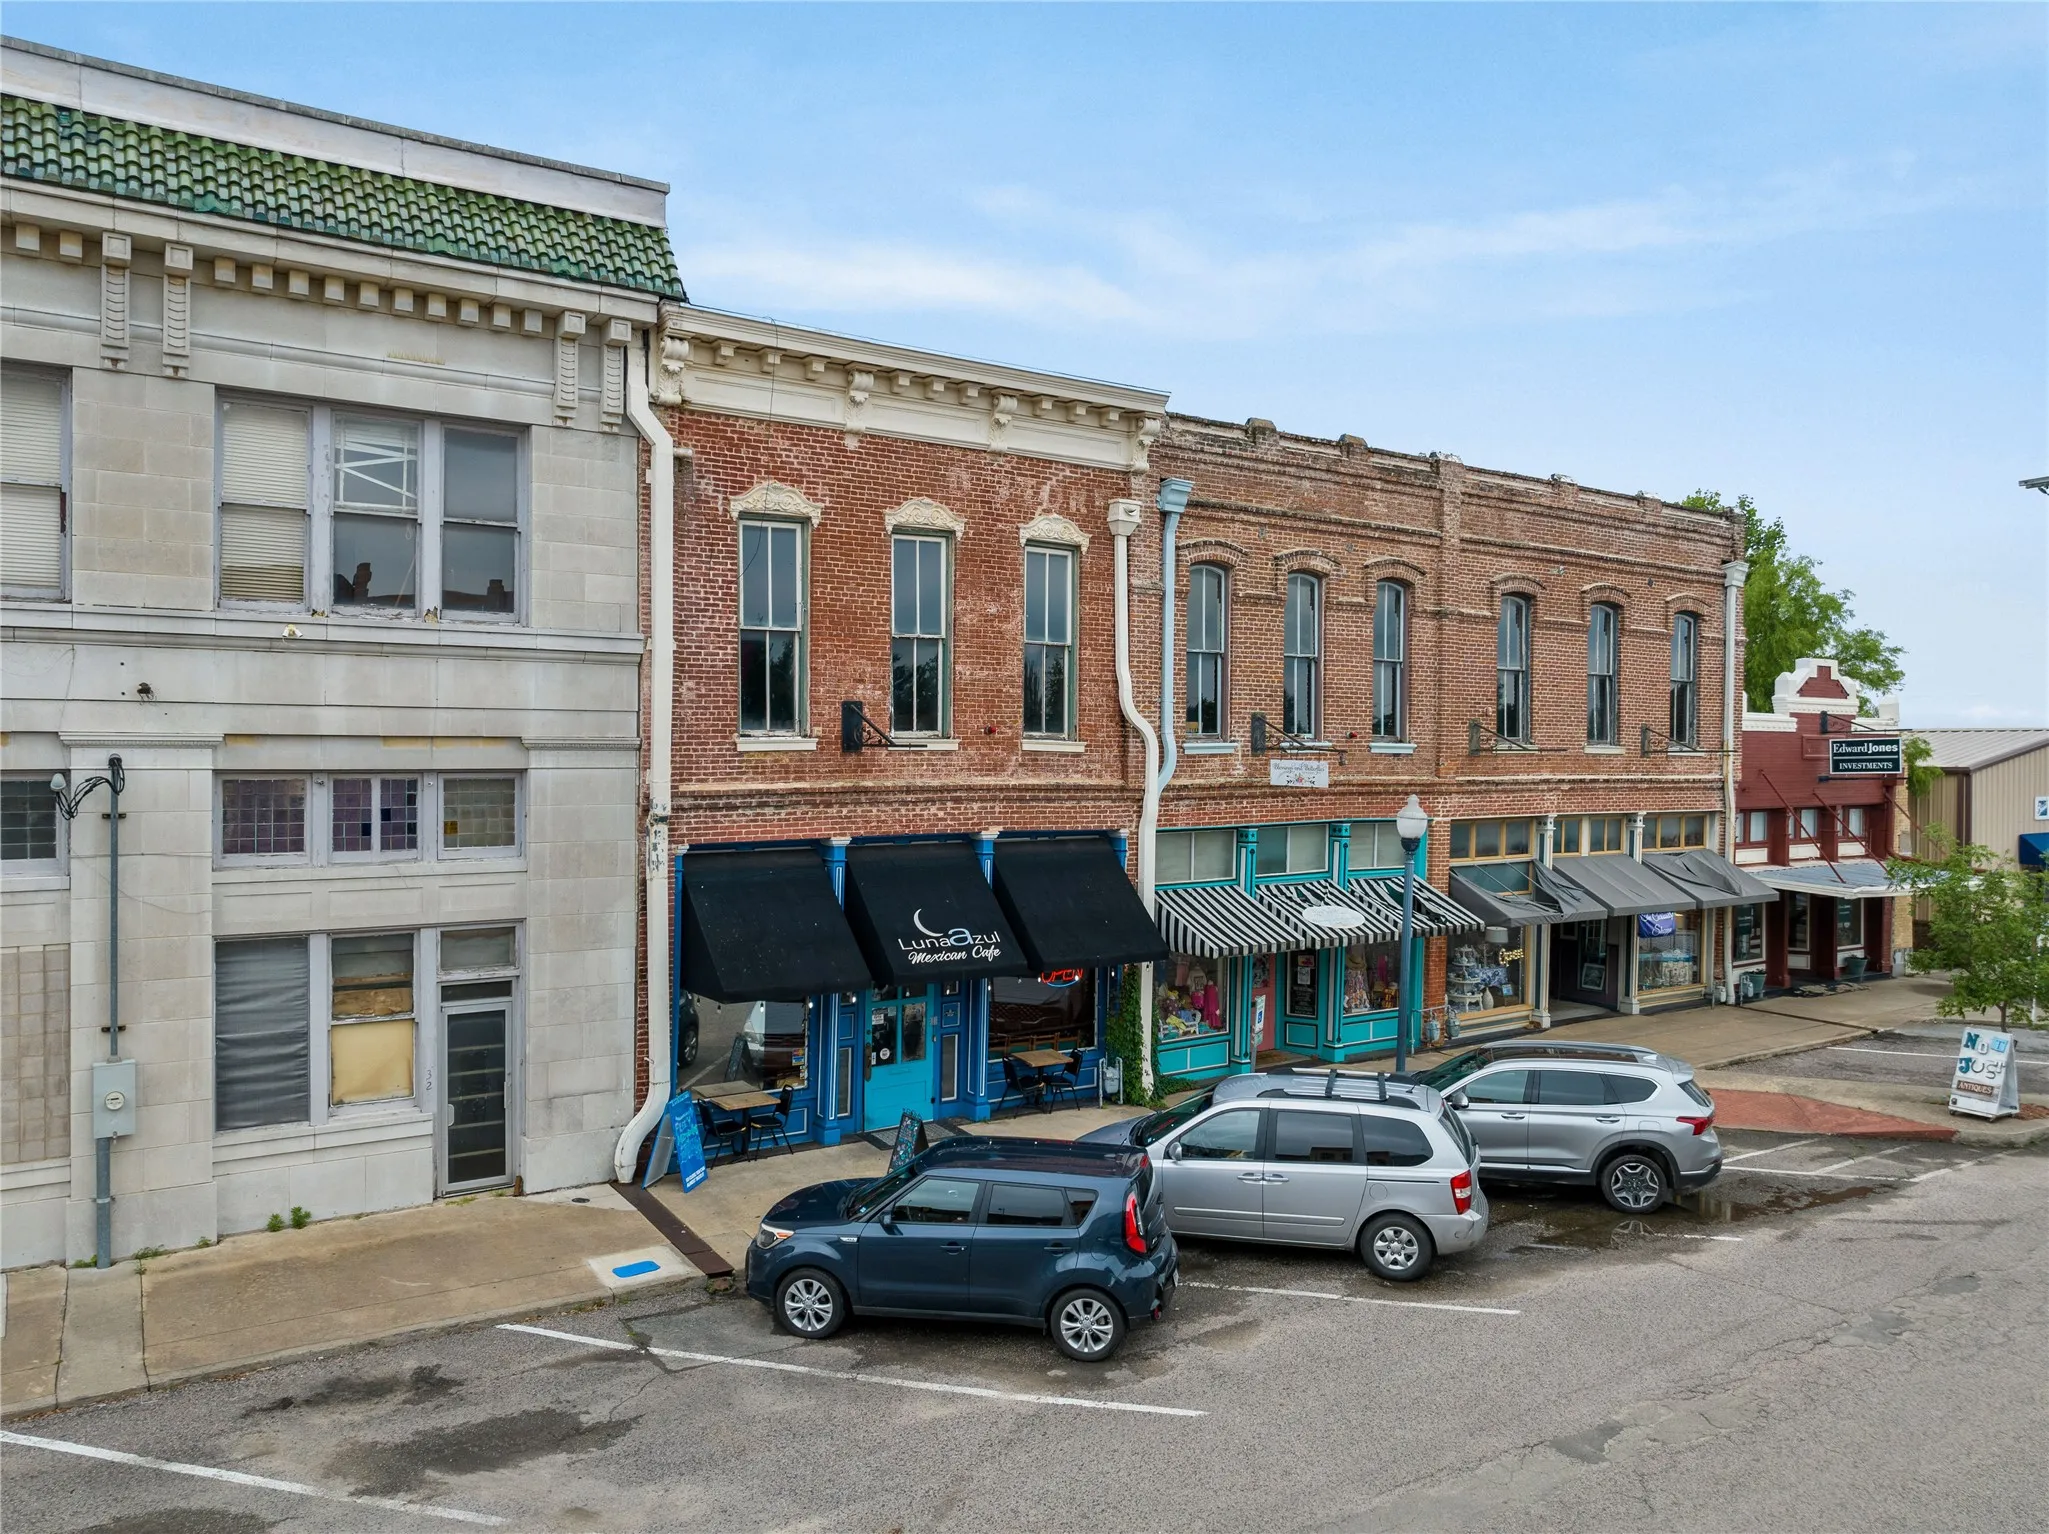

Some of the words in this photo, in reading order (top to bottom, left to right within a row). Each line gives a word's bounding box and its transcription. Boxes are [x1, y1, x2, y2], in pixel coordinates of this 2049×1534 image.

[1839, 762, 1893, 770] INVESTMENTS
[908, 951, 967, 965] Mexican
[972, 945, 1001, 962] Cafe
[1957, 1081, 1993, 1095] ANTIQUES
